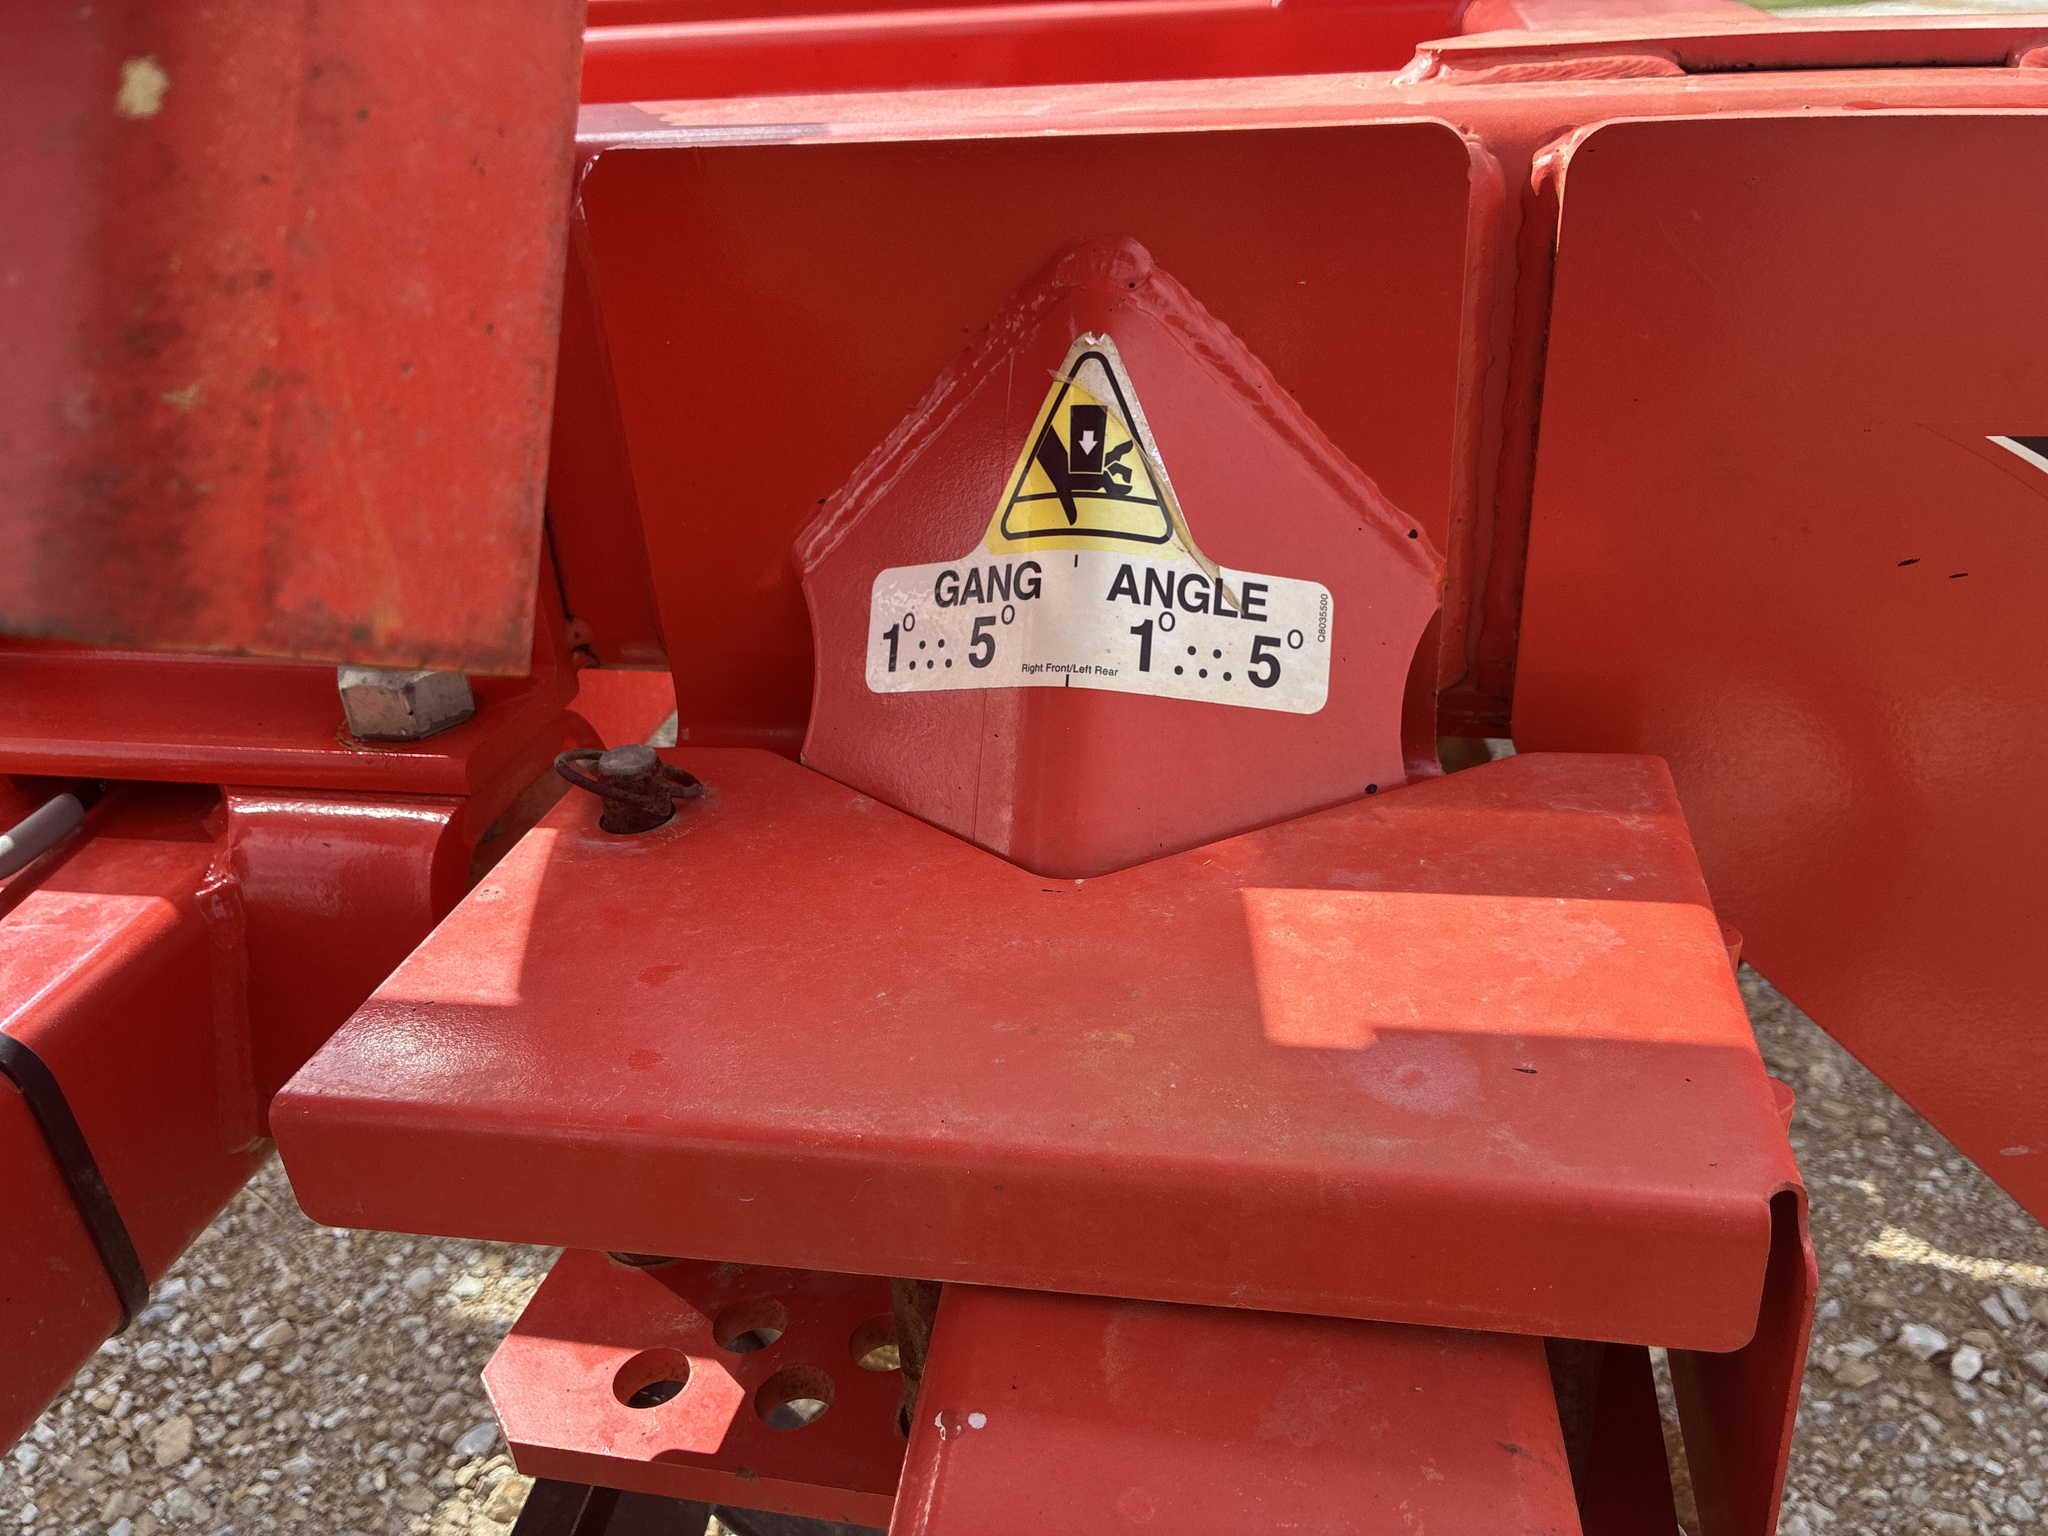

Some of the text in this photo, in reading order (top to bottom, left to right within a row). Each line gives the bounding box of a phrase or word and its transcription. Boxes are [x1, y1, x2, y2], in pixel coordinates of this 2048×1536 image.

[934, 560, 1268, 622] GANG ANGLE
[1317, 593, 1328, 643] Q8035500
[1021, 663, 1119, 676] Right Front/Left Rear
